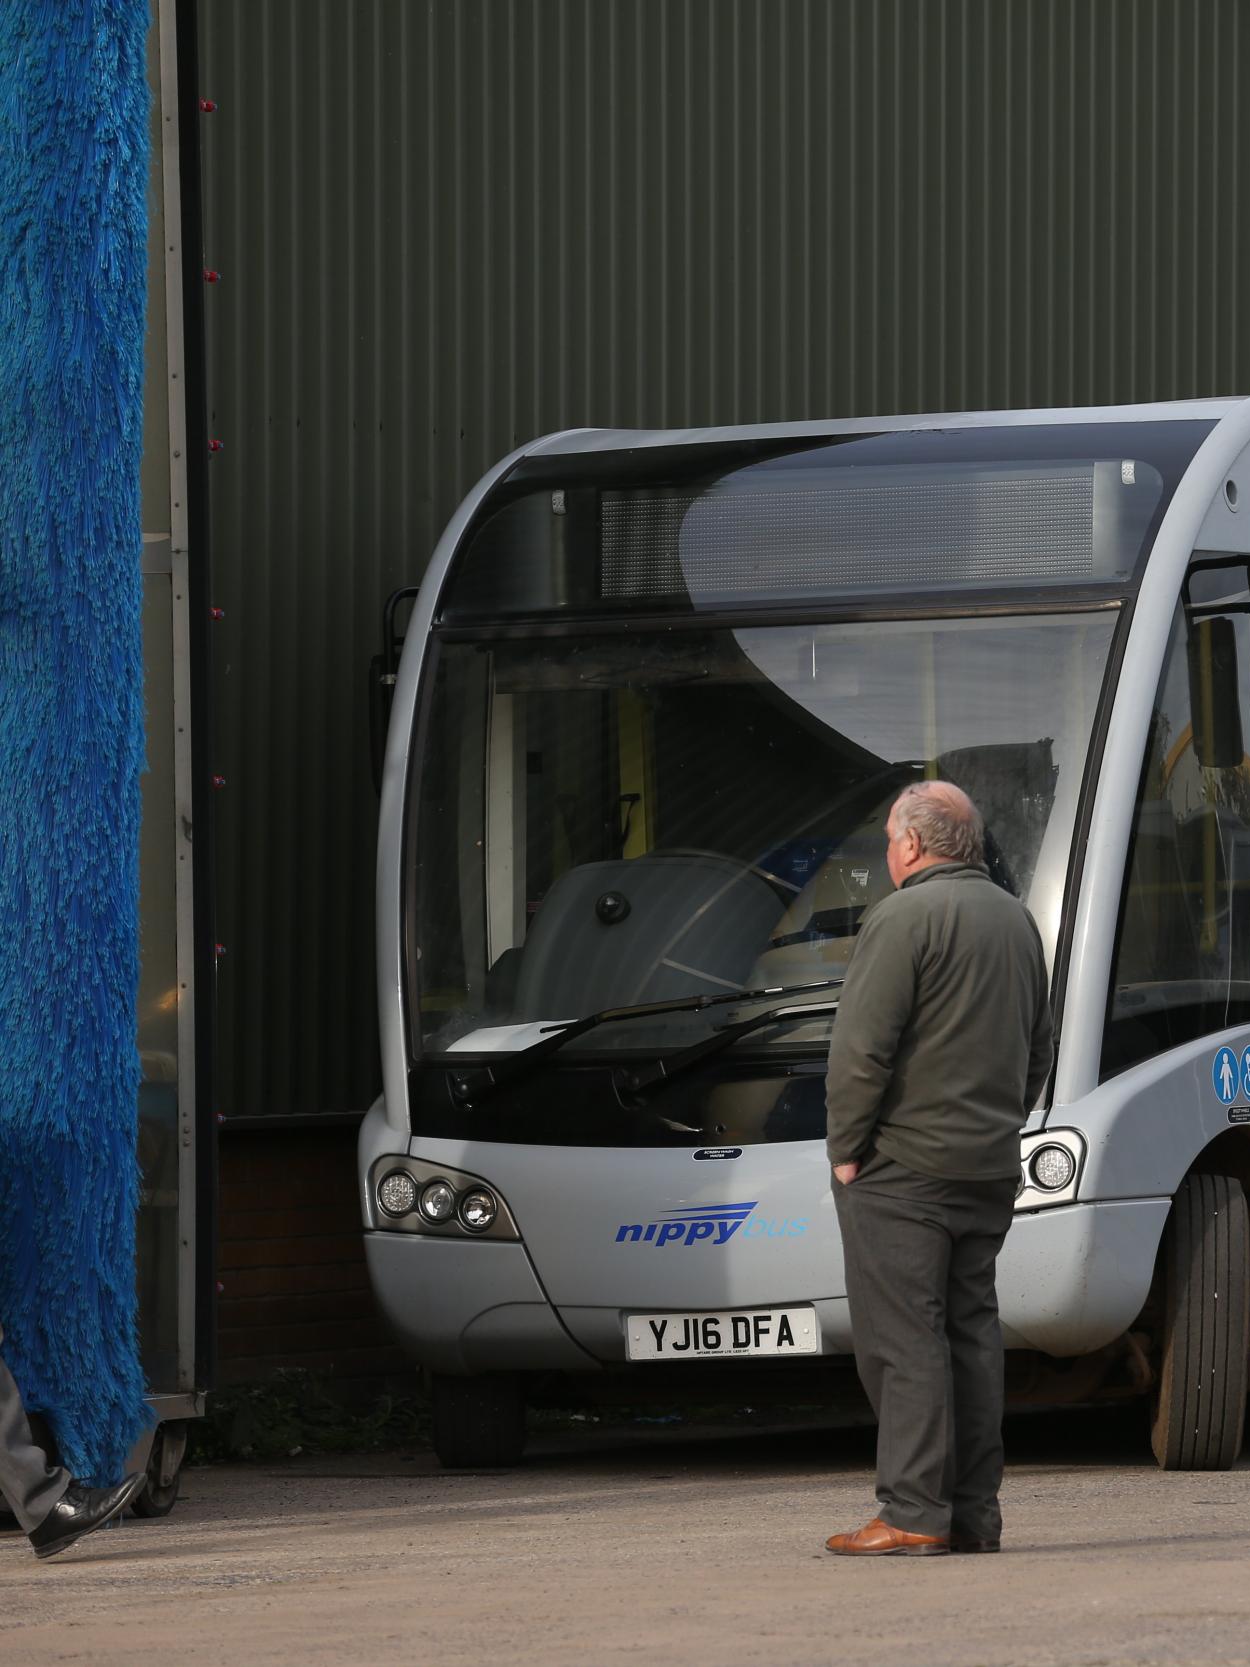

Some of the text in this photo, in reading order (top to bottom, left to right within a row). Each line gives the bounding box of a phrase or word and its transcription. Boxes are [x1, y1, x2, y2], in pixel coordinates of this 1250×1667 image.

[615, 1214, 813, 1247] nippybus
[649, 1314, 795, 1352] YJ16 DFA
